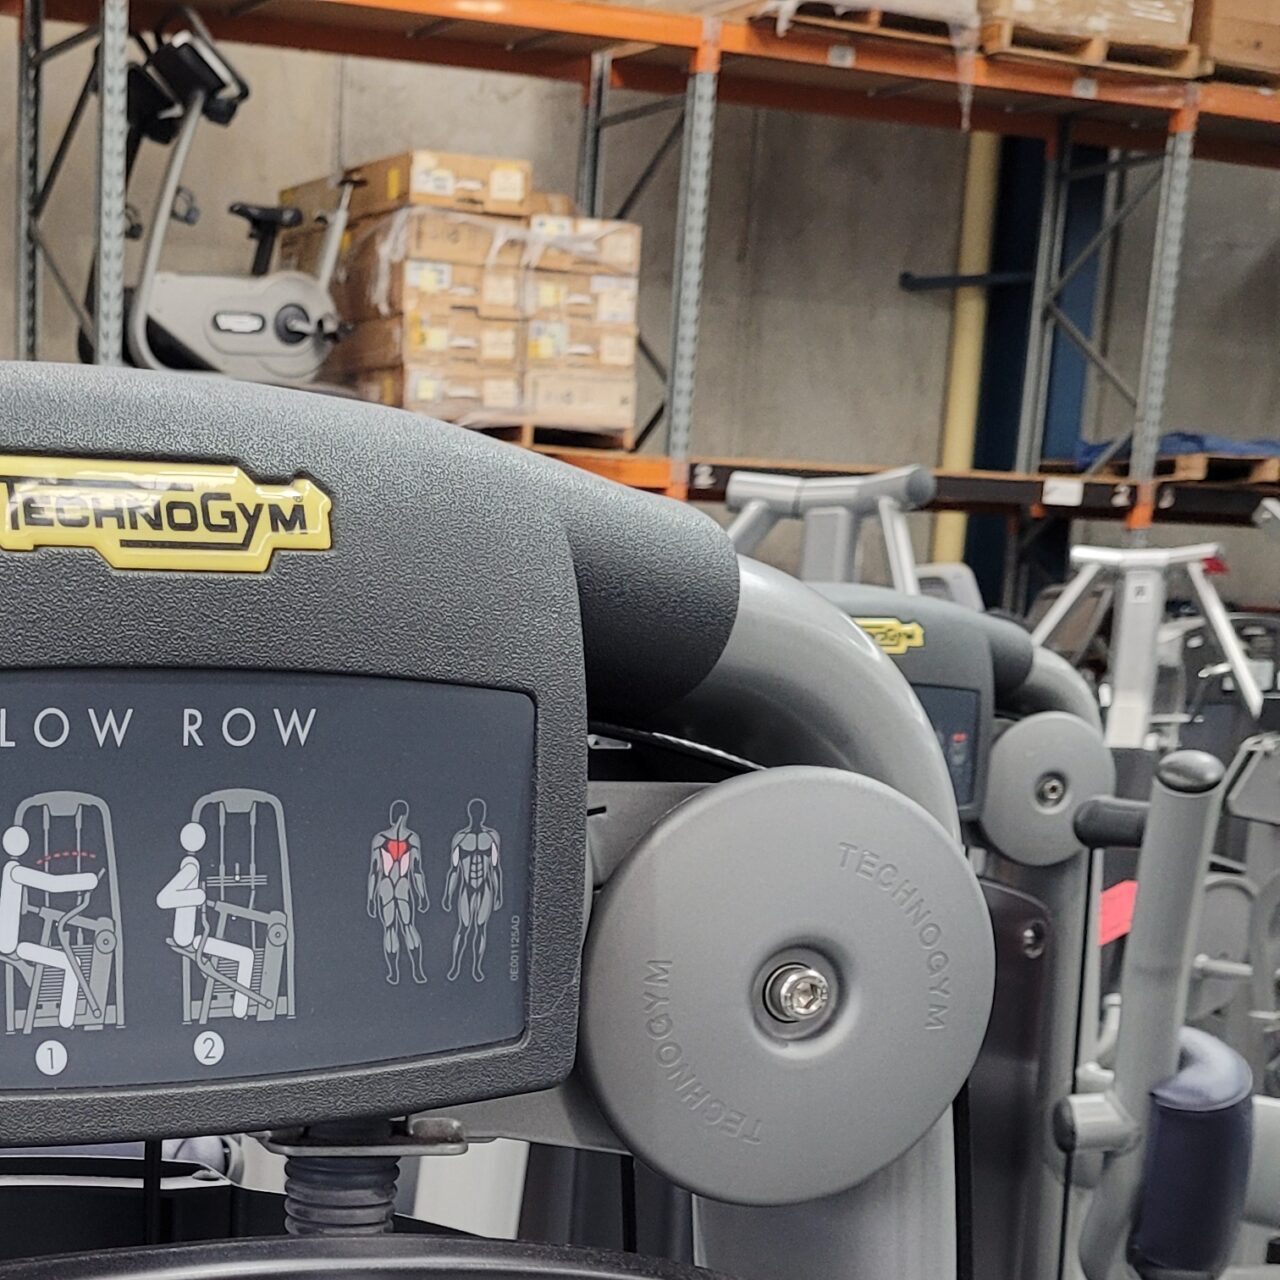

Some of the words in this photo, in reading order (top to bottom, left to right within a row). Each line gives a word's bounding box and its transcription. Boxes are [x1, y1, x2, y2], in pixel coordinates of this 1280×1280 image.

[0, 706, 134, 748] LOW
[182, 706, 318, 747] ROW
[838, 841, 951, 1030] TECHNOGYM
[202, 1037, 217, 1059] 2
[642, 960, 763, 1145] TECHNOGYM
